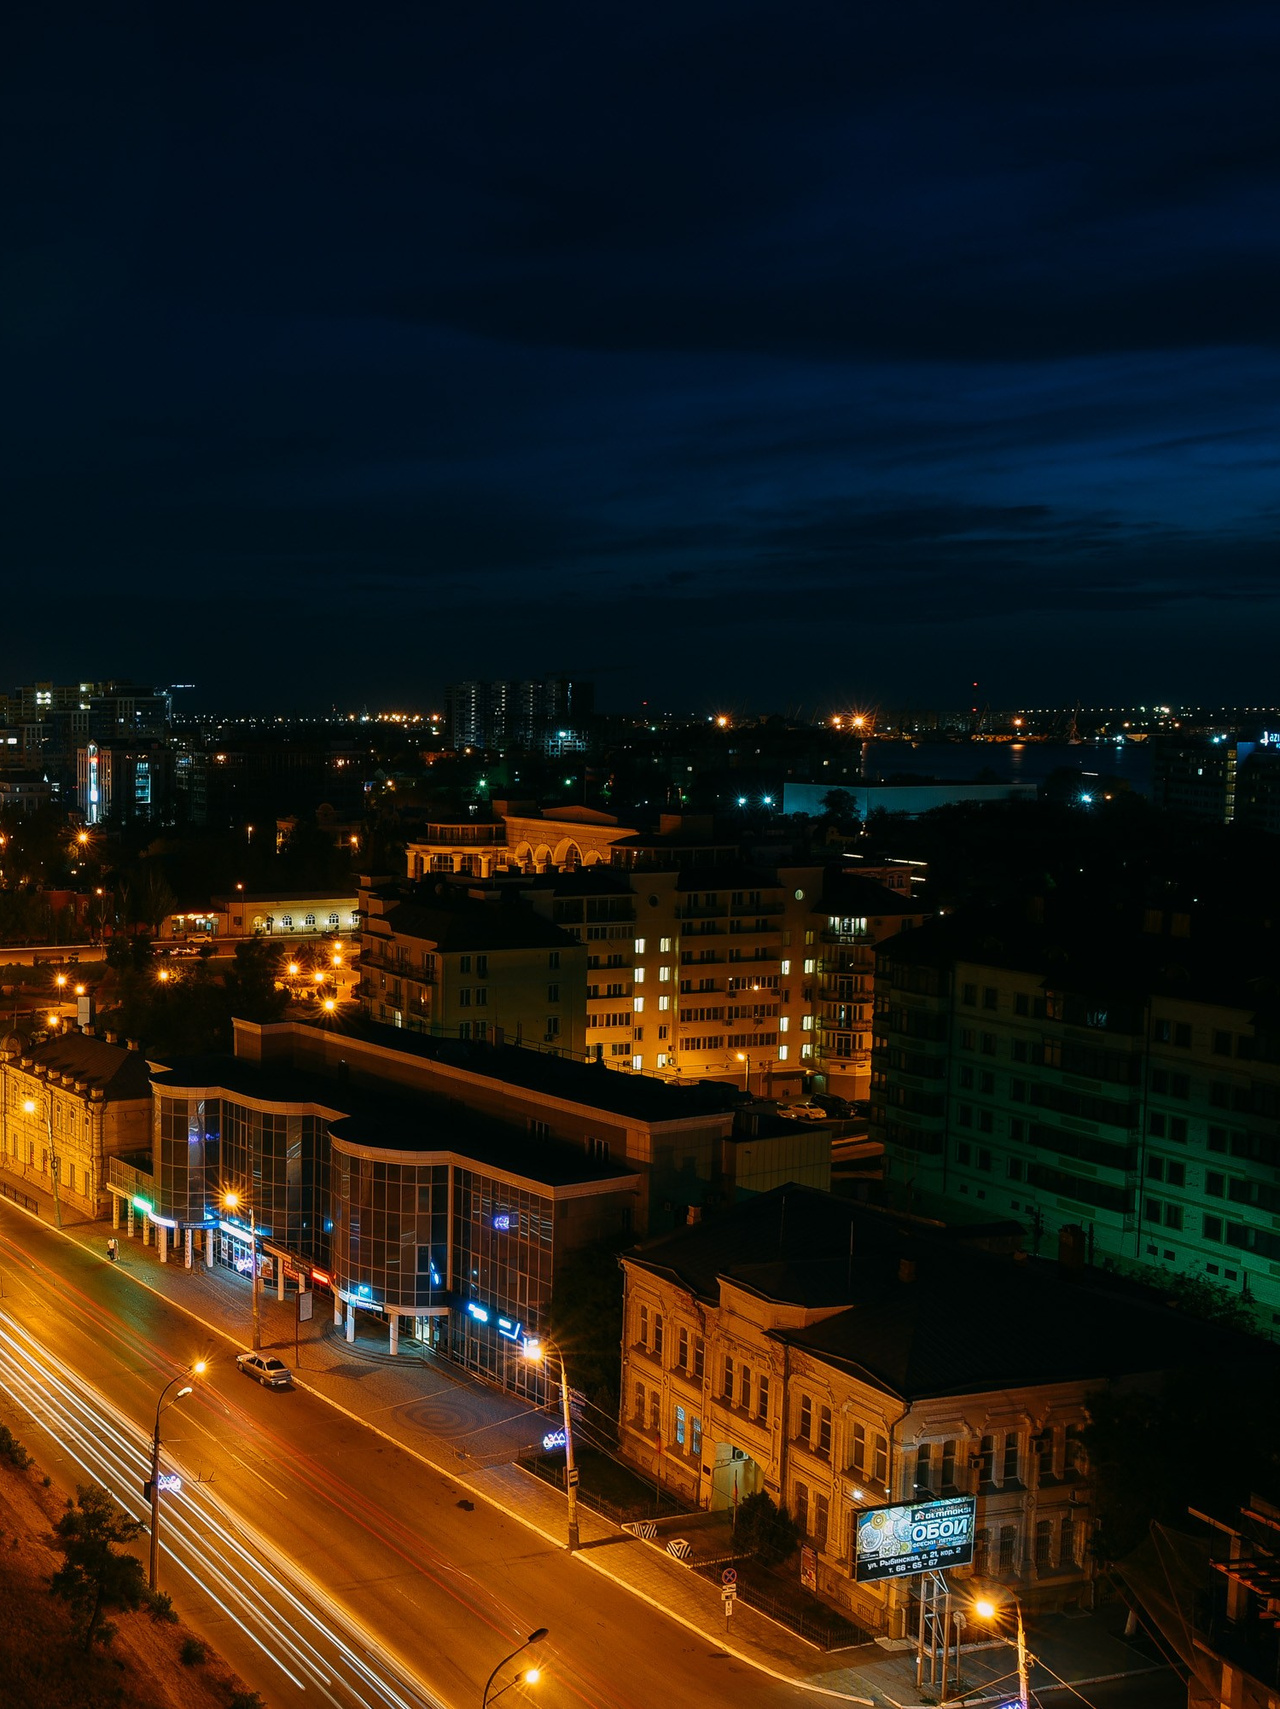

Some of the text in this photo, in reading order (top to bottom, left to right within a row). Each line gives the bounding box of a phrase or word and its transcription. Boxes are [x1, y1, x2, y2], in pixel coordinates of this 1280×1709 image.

[912, 1518, 967, 1542] ОБОИ
[867, 1562, 878, 1570] ул.
[940, 1549, 954, 1557] кор.
[928, 1558, 938, 1566] 67
